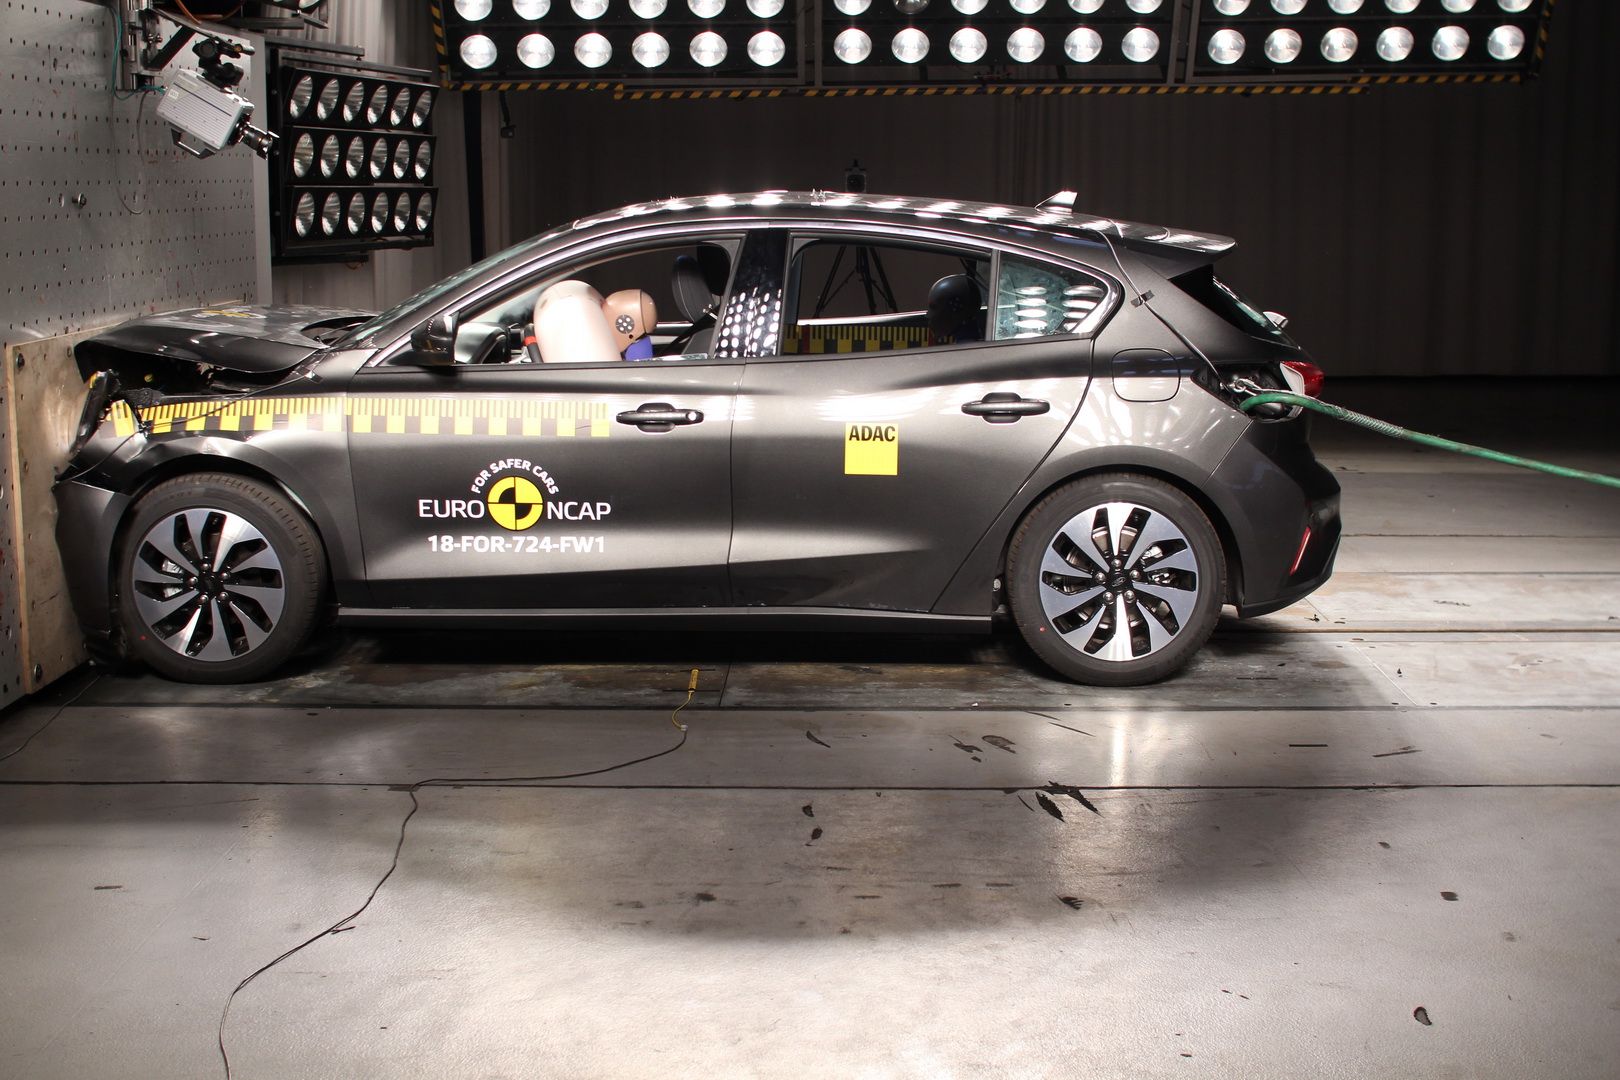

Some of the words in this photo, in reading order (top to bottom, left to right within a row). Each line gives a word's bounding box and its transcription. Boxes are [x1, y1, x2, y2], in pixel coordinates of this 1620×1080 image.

[848, 425, 896, 442] ADAC
[471, 469, 492, 494] FOR
[489, 458, 532, 474] SAFER
[532, 465, 560, 495] CARS
[418, 499, 485, 518] EURO
[546, 501, 612, 521] NCAP
[427, 534, 605, 553] 18-FOR-724-FW1
